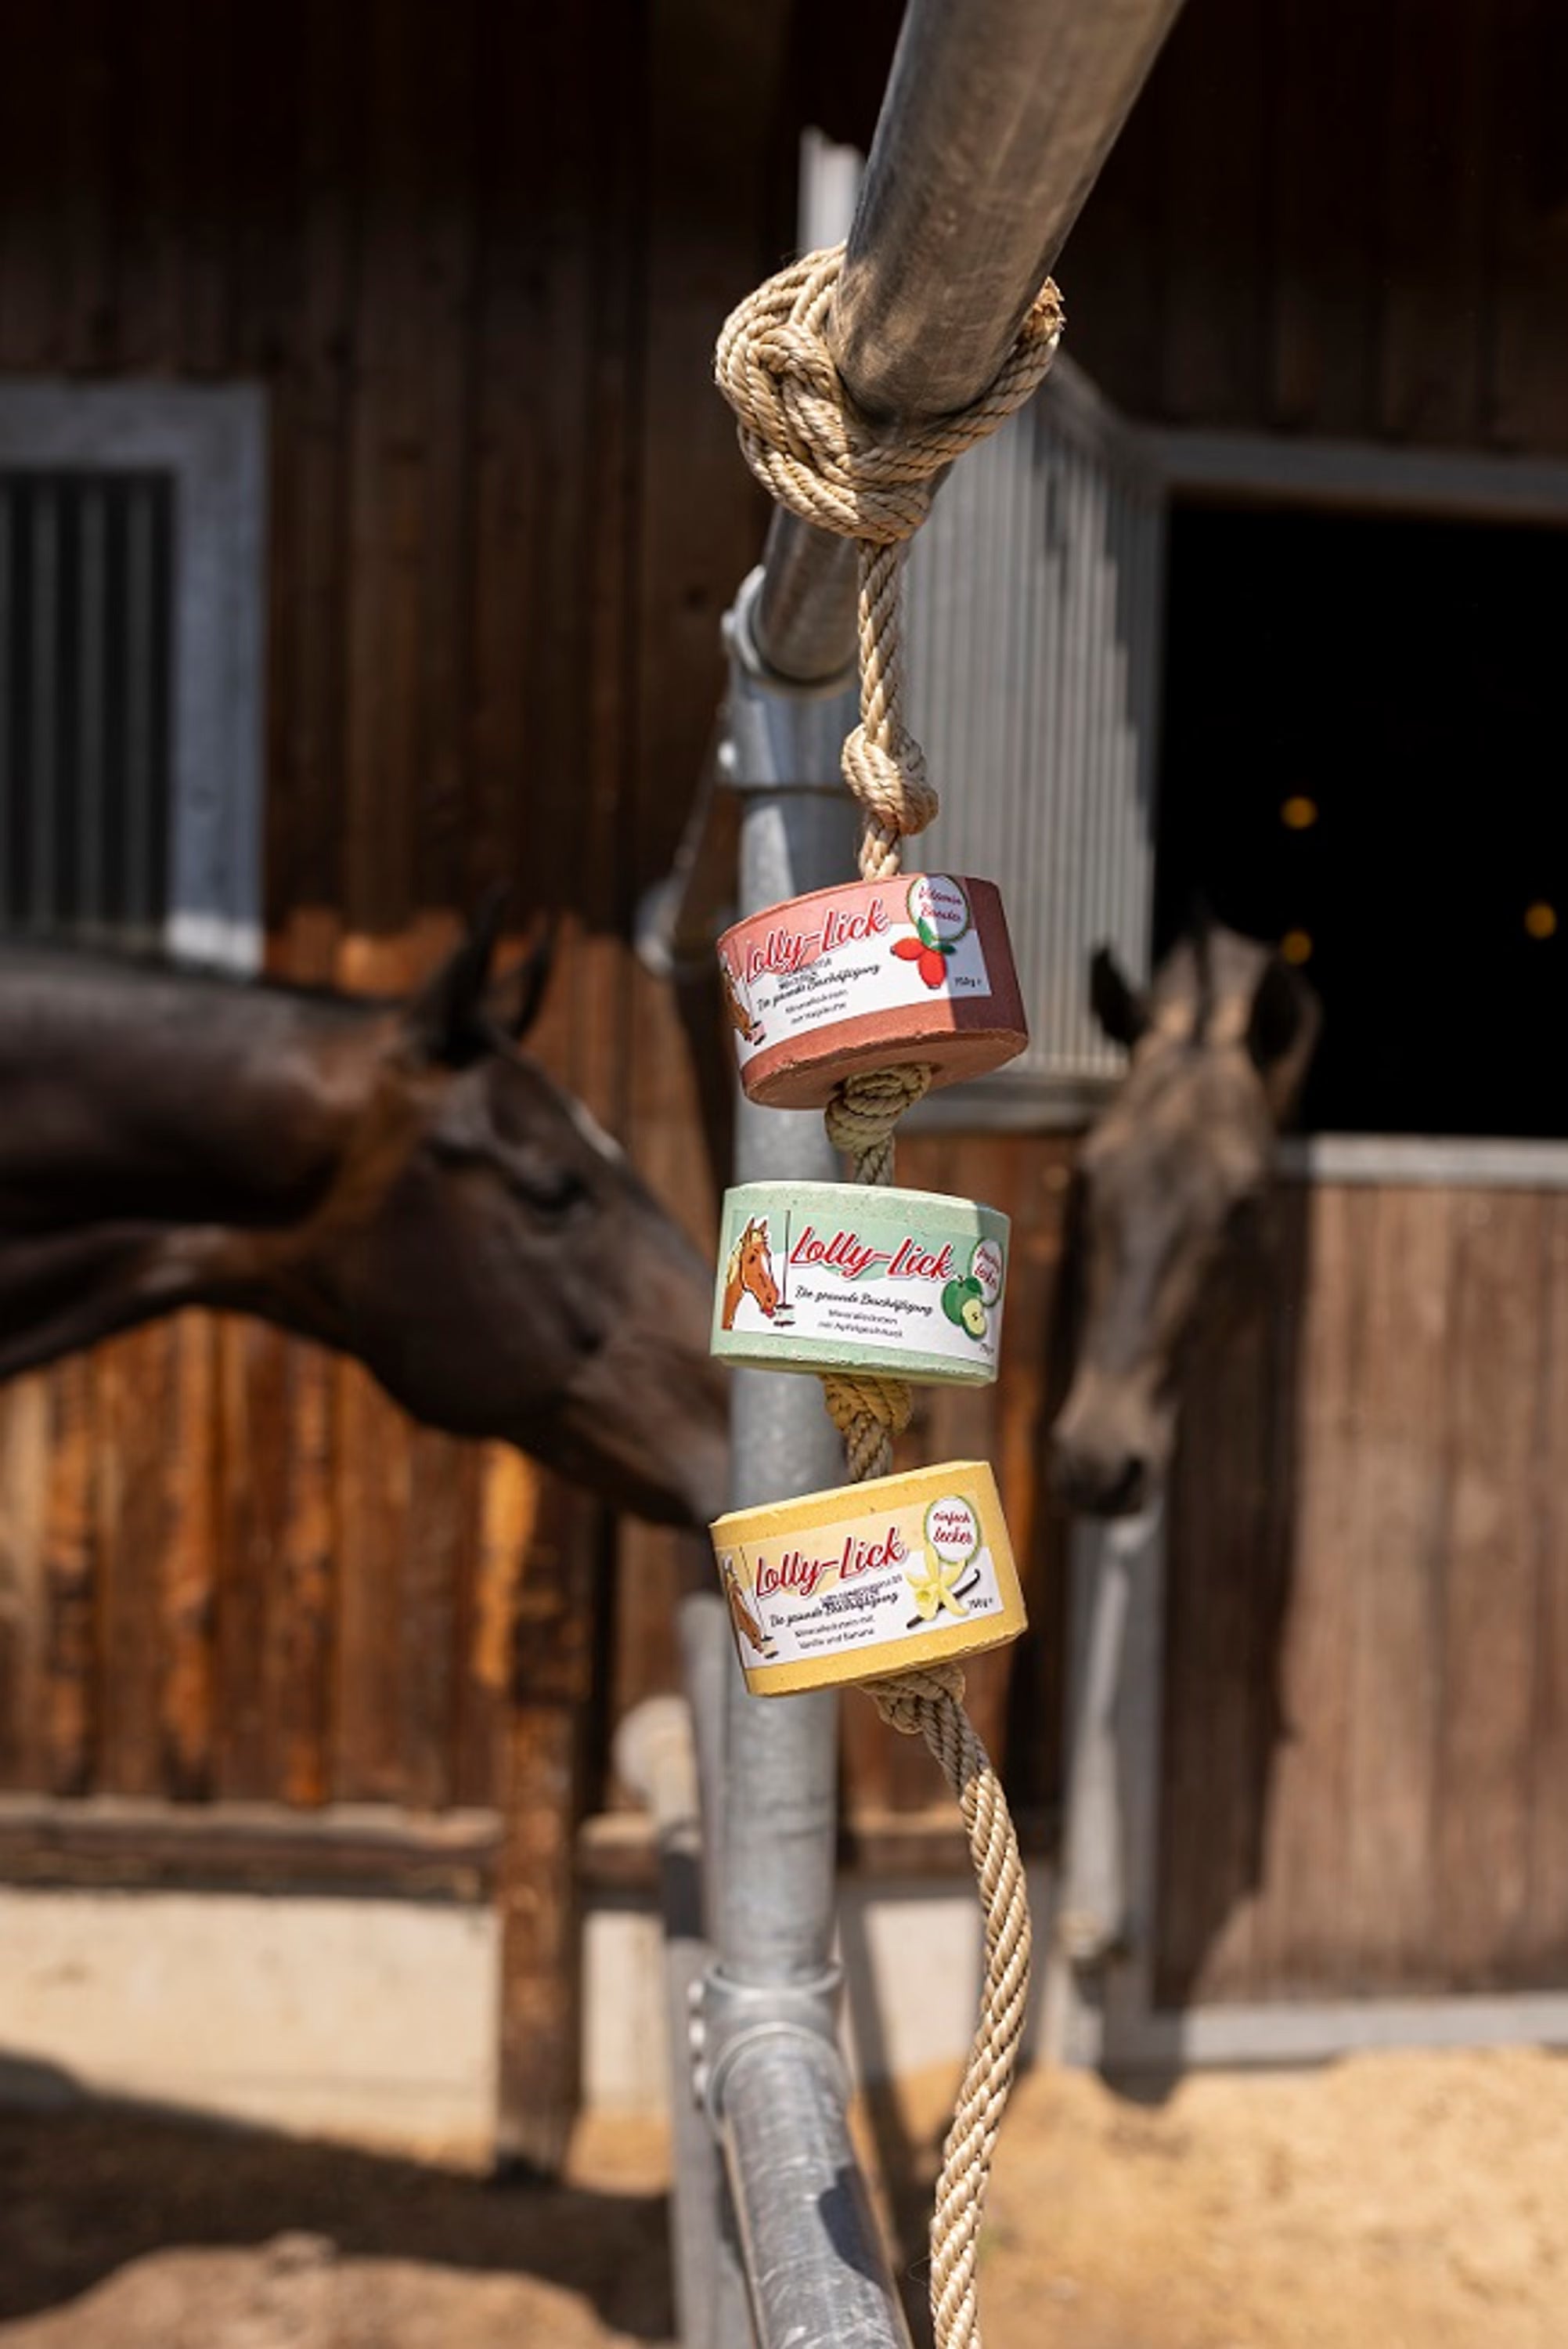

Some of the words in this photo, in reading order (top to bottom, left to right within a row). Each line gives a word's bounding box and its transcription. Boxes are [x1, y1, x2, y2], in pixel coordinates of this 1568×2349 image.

[745, 899, 889, 984] Lolly-Lick
[789, 1226, 954, 1280] Lolly-Lick
[932, 1510, 971, 1526] einfach
[932, 1526, 973, 1545] lecker
[755, 1526, 907, 1597] Lolly-Lick
